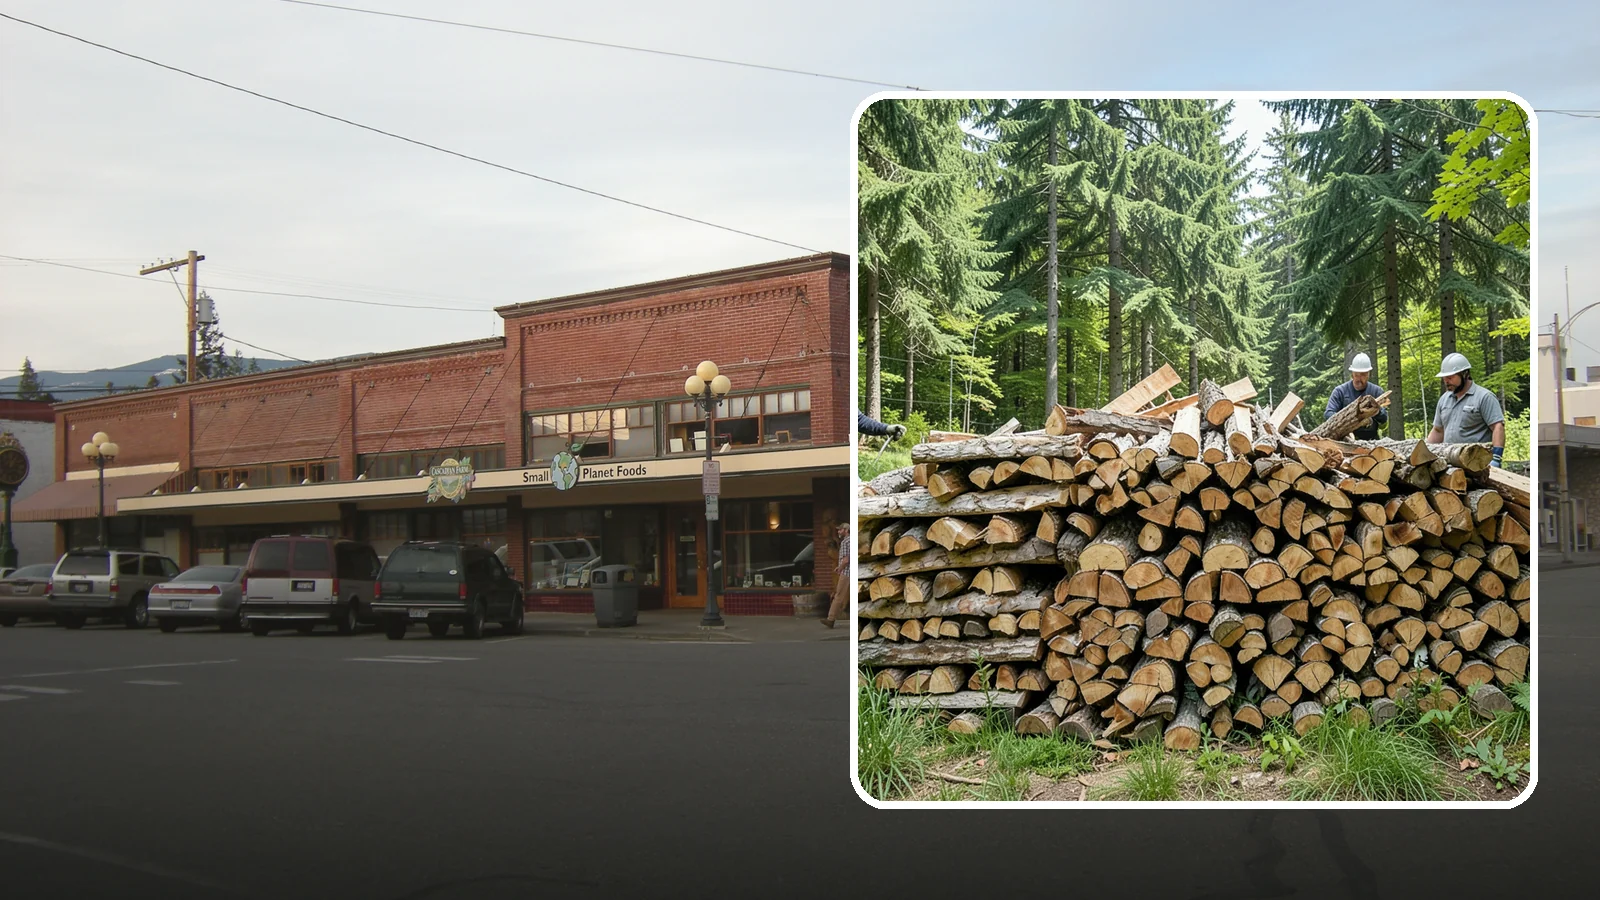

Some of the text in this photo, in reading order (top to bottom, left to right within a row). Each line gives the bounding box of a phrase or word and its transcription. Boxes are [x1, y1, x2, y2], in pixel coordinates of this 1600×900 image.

[523, 464, 647, 483] Small Planet Foods
